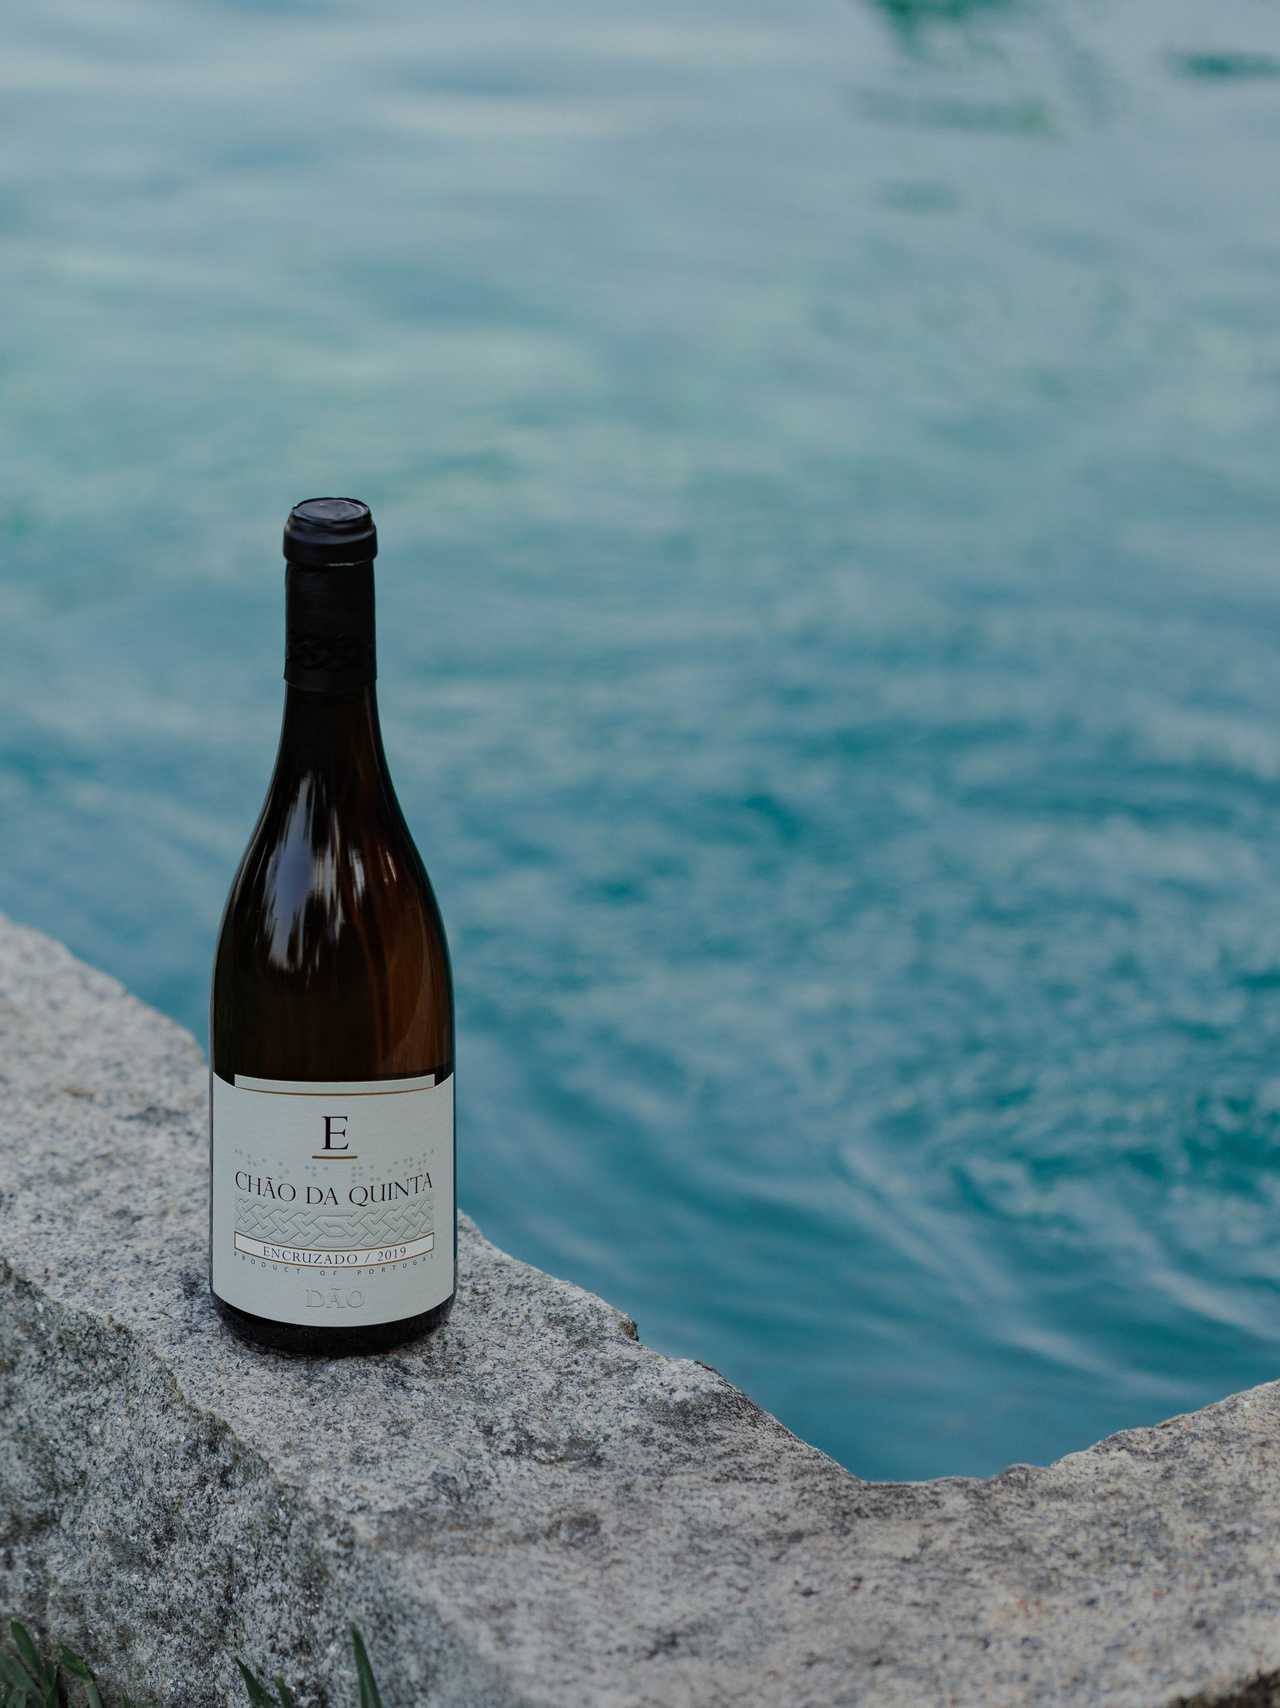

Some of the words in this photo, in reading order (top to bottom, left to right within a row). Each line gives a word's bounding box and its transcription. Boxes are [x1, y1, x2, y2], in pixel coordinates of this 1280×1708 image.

[321, 1115, 349, 1150] E
[235, 1170, 297, 1202] CHÃO
[306, 1186, 339, 1206] DA
[348, 1172, 433, 1207] QUINTA
[233, 1251, 301, 1275] PRODUCT
[357, 1253, 434, 1276] PORTUGAL
[263, 1246, 358, 1265] ENCRUZADO
[377, 1246, 407, 1262] 2019
[305, 1287, 365, 1309] DÃO
